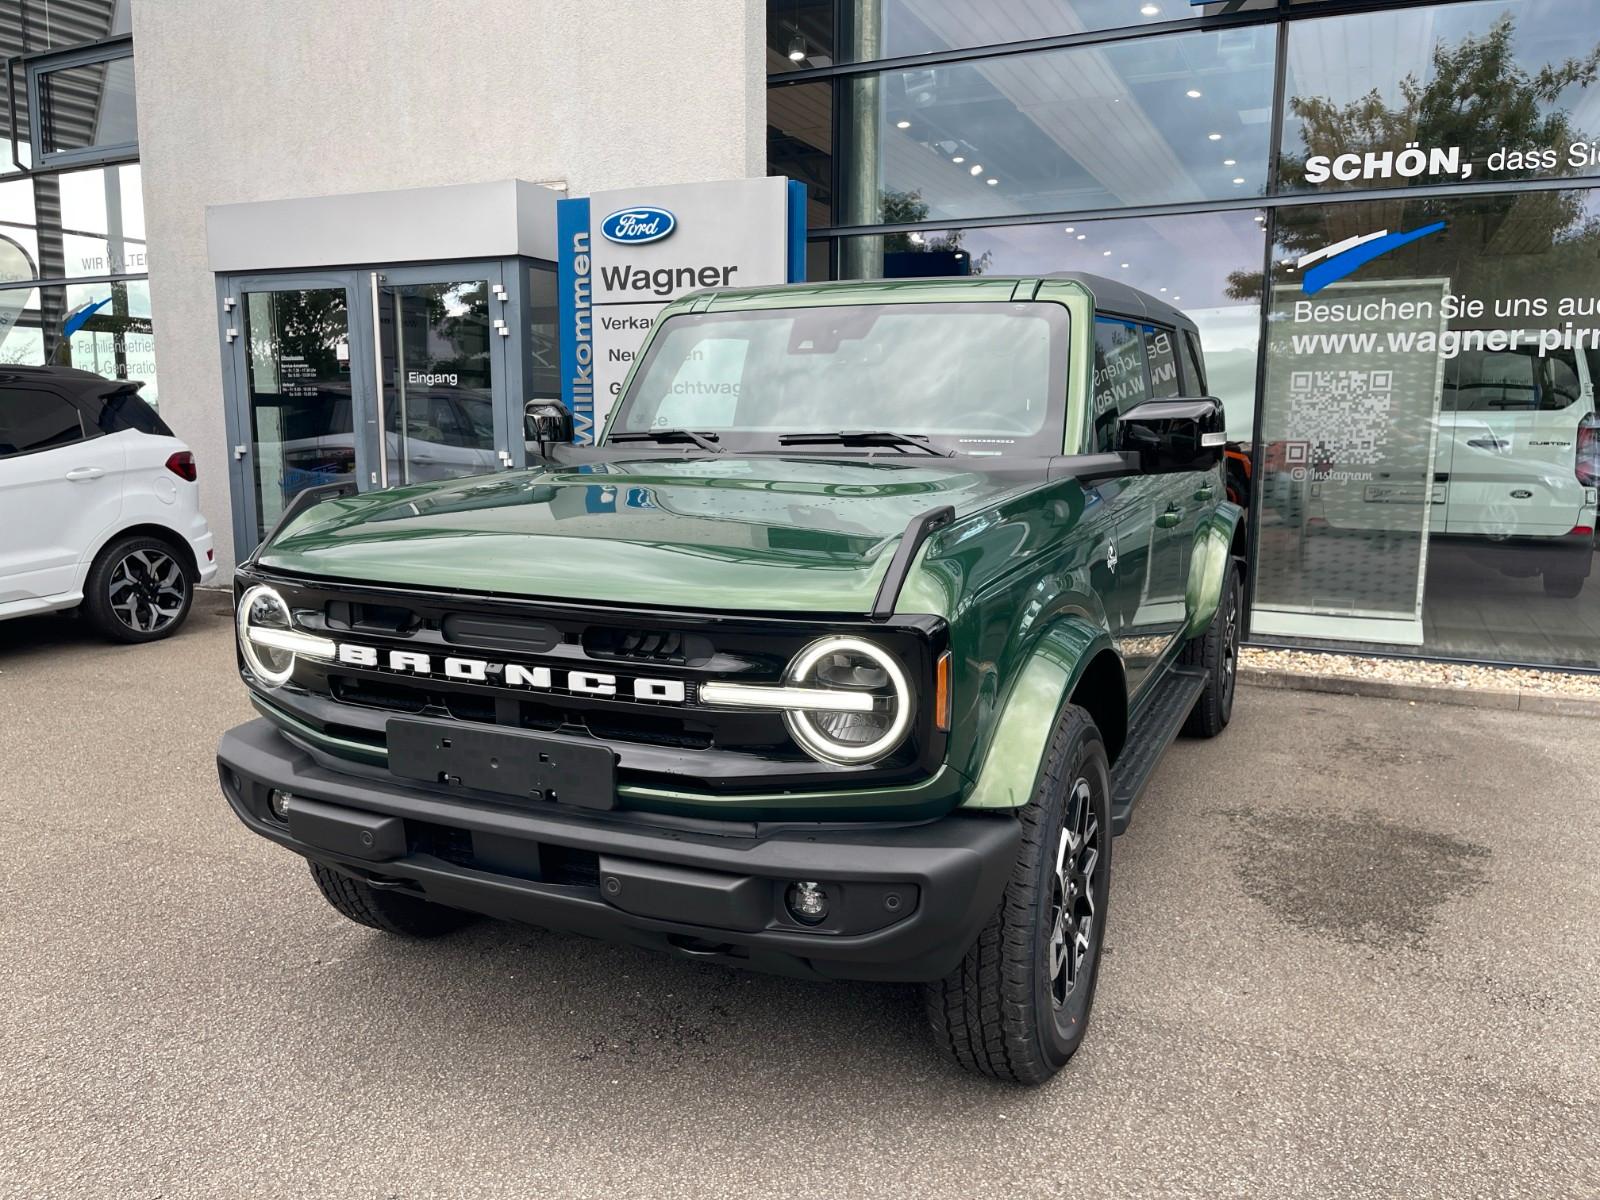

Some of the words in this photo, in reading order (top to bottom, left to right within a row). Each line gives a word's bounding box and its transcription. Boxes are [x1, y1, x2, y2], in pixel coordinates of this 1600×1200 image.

[1304, 142, 1473, 183] SCHÖN,
[1487, 147, 1557, 172] dass
[1567, 142, 1600, 167] Si
[614, 212, 661, 238] Ford
[81, 257, 104, 271] WIR
[106, 253, 148, 269] HALTE
[601, 264, 738, 296] Wagner
[1294, 298, 1433, 323] Besuchen
[1439, 294, 1484, 320] Sie
[1494, 297, 1548, 318] uns
[1557, 297, 1600, 316] au
[573, 232, 593, 446] Willkommen
[408, 371, 458, 386] Eingang
[1309, 467, 1374, 486] Instagram
[339, 642, 685, 703] BRONCO
